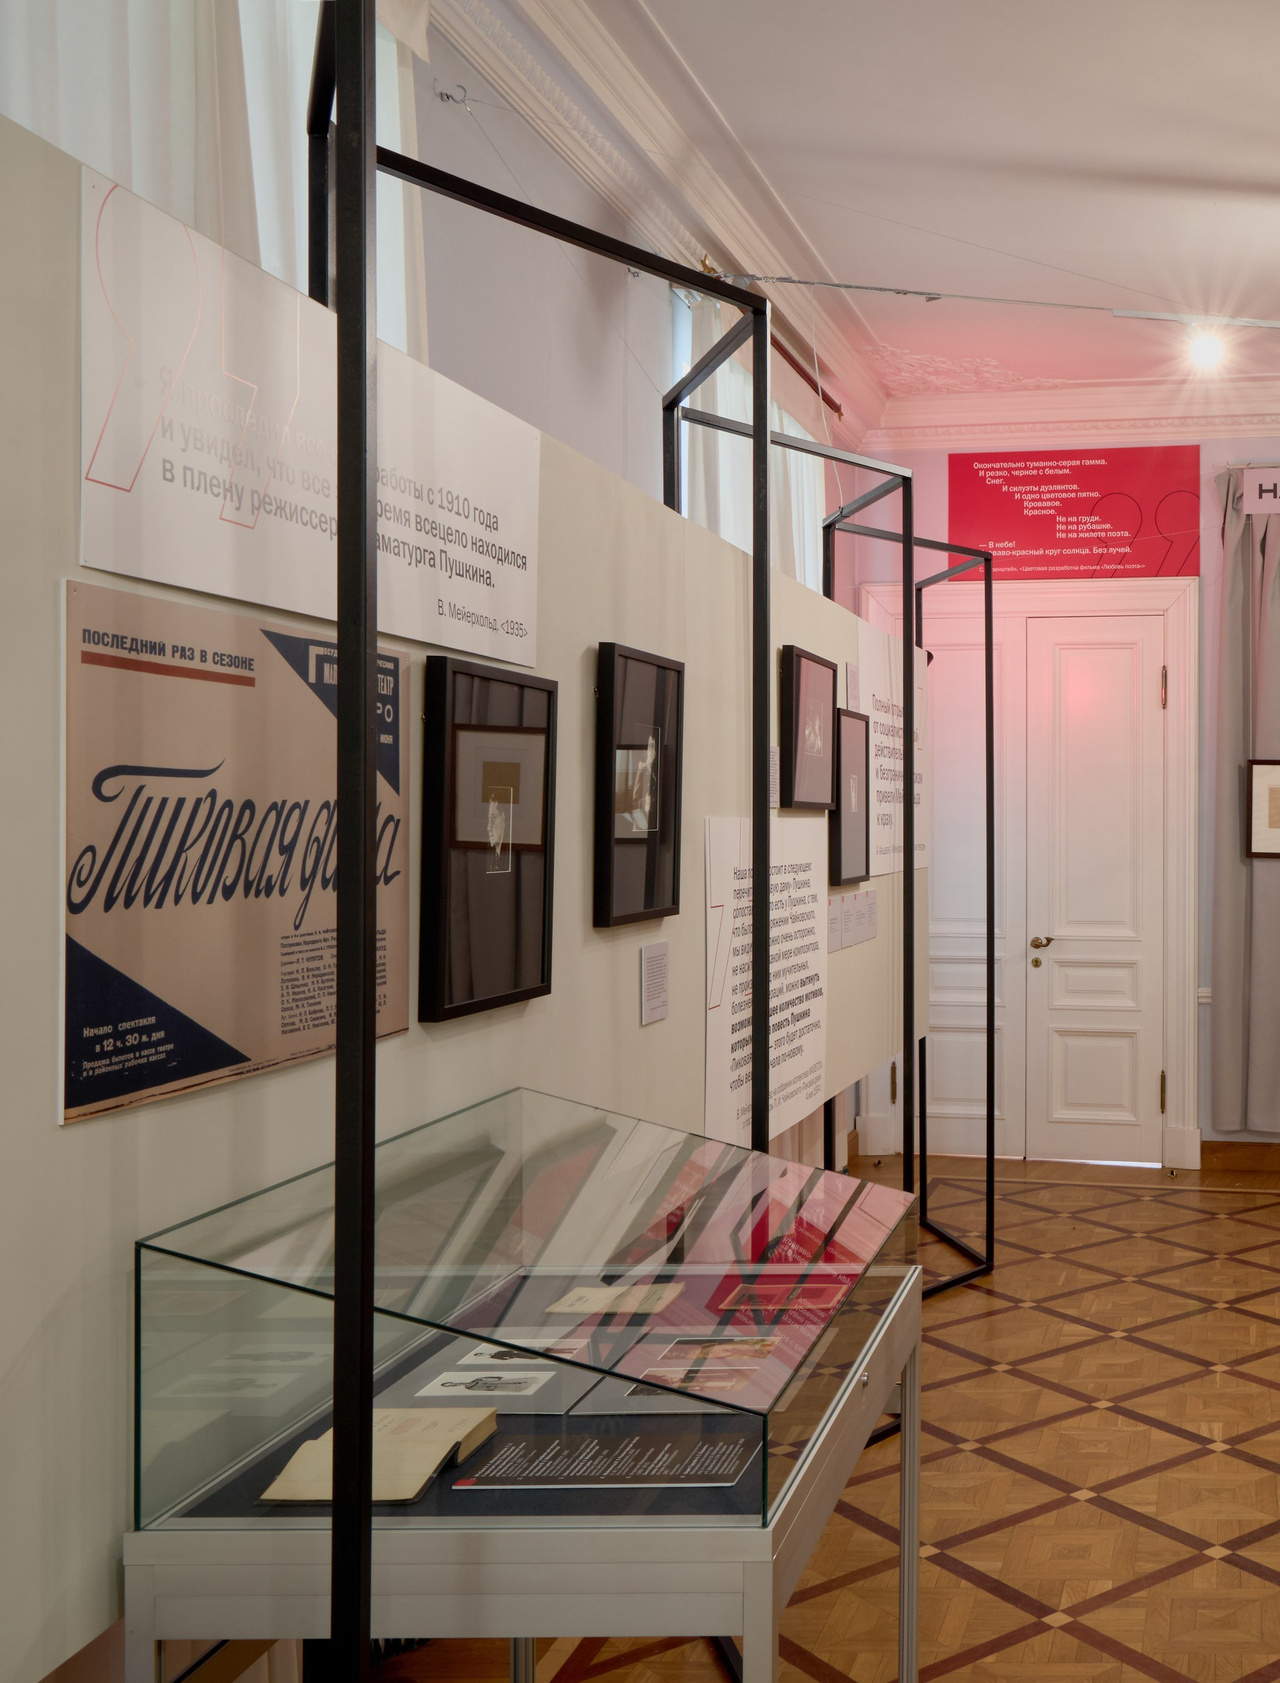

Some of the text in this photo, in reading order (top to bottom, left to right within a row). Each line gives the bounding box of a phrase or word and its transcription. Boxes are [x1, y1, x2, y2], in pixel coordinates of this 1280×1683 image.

[180, 423, 331, 498] увидел, что все
[1026, 460, 1081, 469] туманно-серая
[986, 470, 1010, 478] резко,
[162, 458, 337, 540] в плену режиссер
[1009, 484, 1080, 493] силуэты дуэлянтов.
[1041, 492, 1076, 500] цветовое
[438, 488, 470, 519] 1910
[474, 506, 499, 533] года
[1024, 500, 1062, 508] Кровавое.
[1024, 508, 1057, 516] Красное.
[377, 499, 527, 571] ремя всецело находился
[1079, 523, 1113, 531] рубашке.
[1108, 546, 1132, 554] лучей.
[440, 549, 495, 588] Пушкина.
[438, 599, 528, 638] В. Мейерхольд. <1935>
[82, 628, 254, 671] ПОСЛЕДНИЙ РАЗ В СЕЗОНЕ
[377, 674, 394, 696] ТЕАТР
[67, 758, 401, 931] Пиковая даа
[83, 1016, 156, 1037] Начало спектакля
[103, 1031, 165, 1051] 12 30 дня
[83, 1043, 174, 1070] Продажа билетов кассе театра
[95, 1064, 122, 1075] районных
[125, 1058, 147, 1069] рабочих
